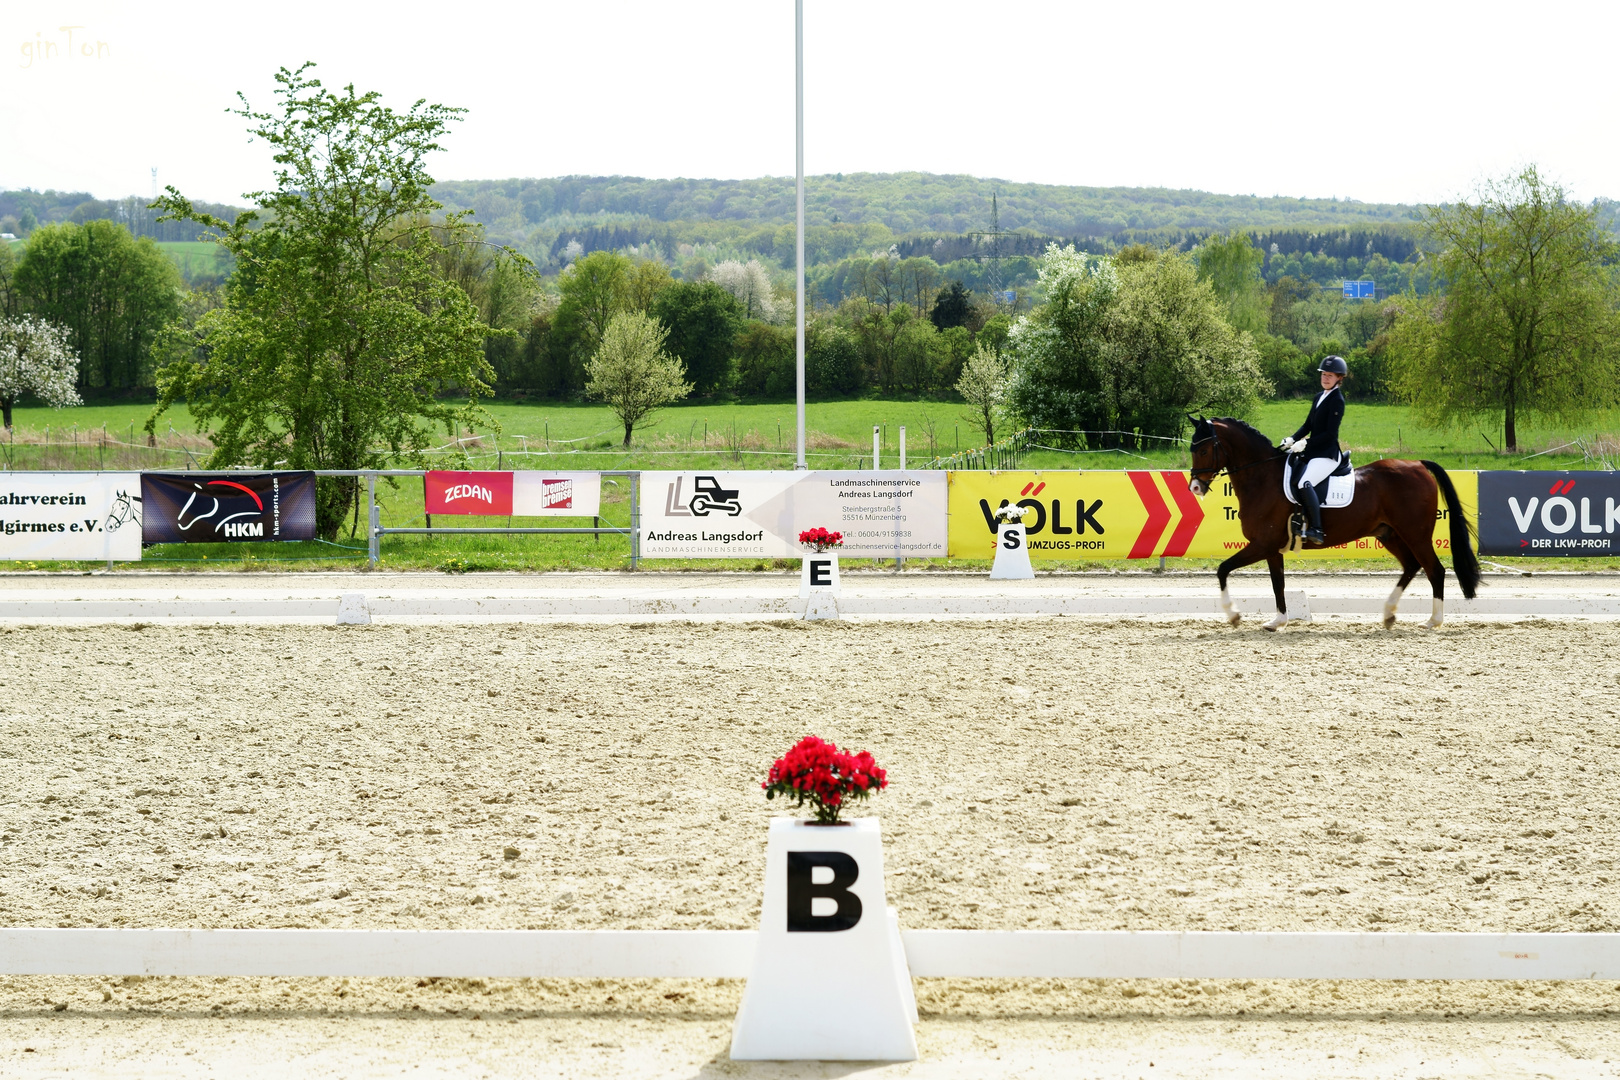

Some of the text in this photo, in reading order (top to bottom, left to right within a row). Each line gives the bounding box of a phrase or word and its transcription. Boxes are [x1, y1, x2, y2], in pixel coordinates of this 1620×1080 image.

[830, 479, 921, 487] Landmaschinenservice
[0, 492, 86, 505] ahrverein
[445, 484, 492, 504] ZEDAN
[838, 489, 913, 499] Andreas Langsdorf
[842, 505, 895, 513] Steinbergstraße
[979, 482, 1105, 535] VÖLK
[1508, 480, 1620, 534] VÖLK
[865, 513, 907, 522] Münzenberg
[224, 522, 264, 537] HKM
[858, 531, 912, 539] 06004/9159838
[647, 530, 763, 544] Andreas Langsdorf
[1003, 530, 1021, 550] S
[1532, 539, 1611, 548] DER LKW-PROFI
[810, 560, 832, 586] E
[787, 851, 863, 932] B
